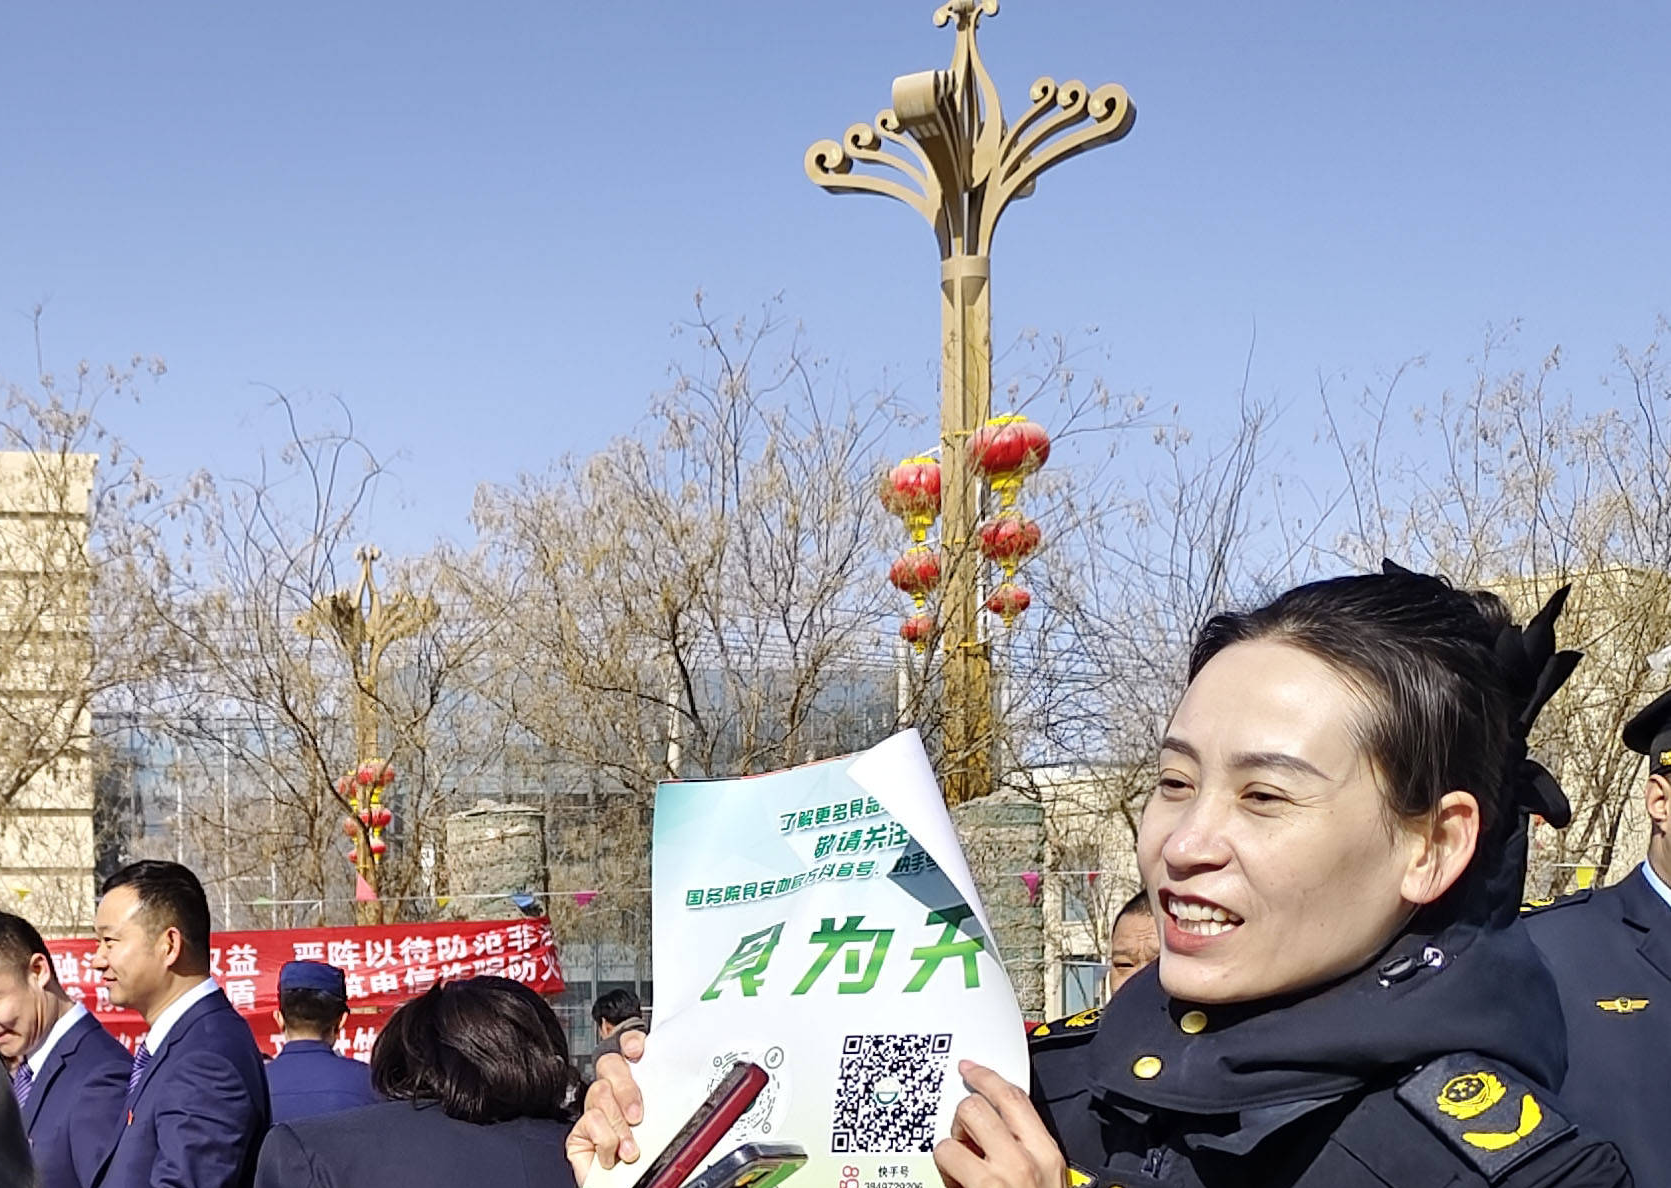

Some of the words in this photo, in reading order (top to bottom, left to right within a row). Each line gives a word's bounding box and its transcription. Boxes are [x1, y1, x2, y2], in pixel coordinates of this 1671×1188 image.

[779, 796, 885, 832] 了解更多食品
[814, 821, 910, 859] 敬请关注
[700, 903, 986, 1001] 食为天
[878, 1166, 909, 1178] 快手号
